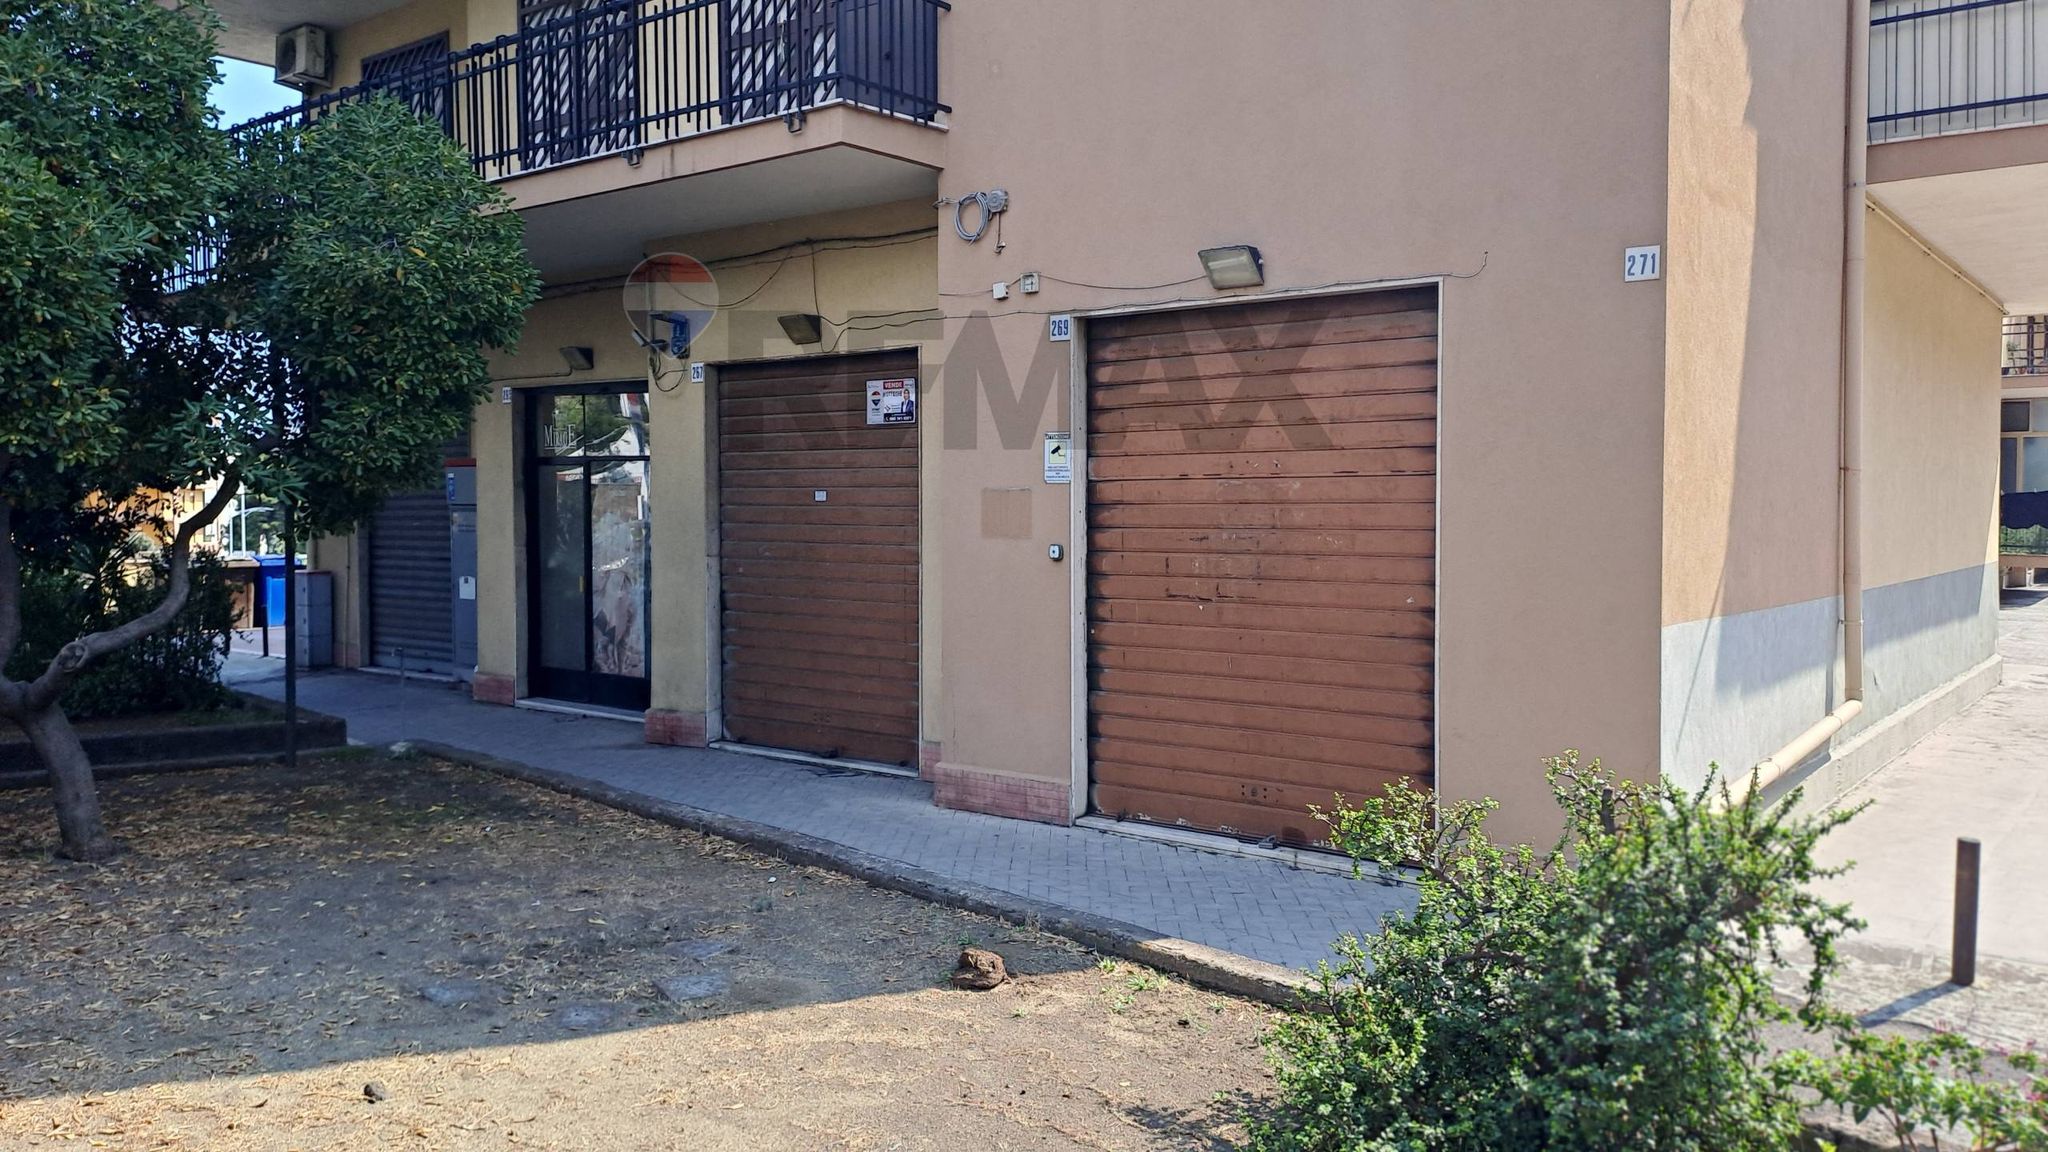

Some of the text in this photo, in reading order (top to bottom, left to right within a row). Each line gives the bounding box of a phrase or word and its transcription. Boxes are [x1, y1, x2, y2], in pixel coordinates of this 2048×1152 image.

[1627, 253, 1656, 276] 271
[1051, 319, 1069, 336] 269
[692, 366, 704, 380] 267
